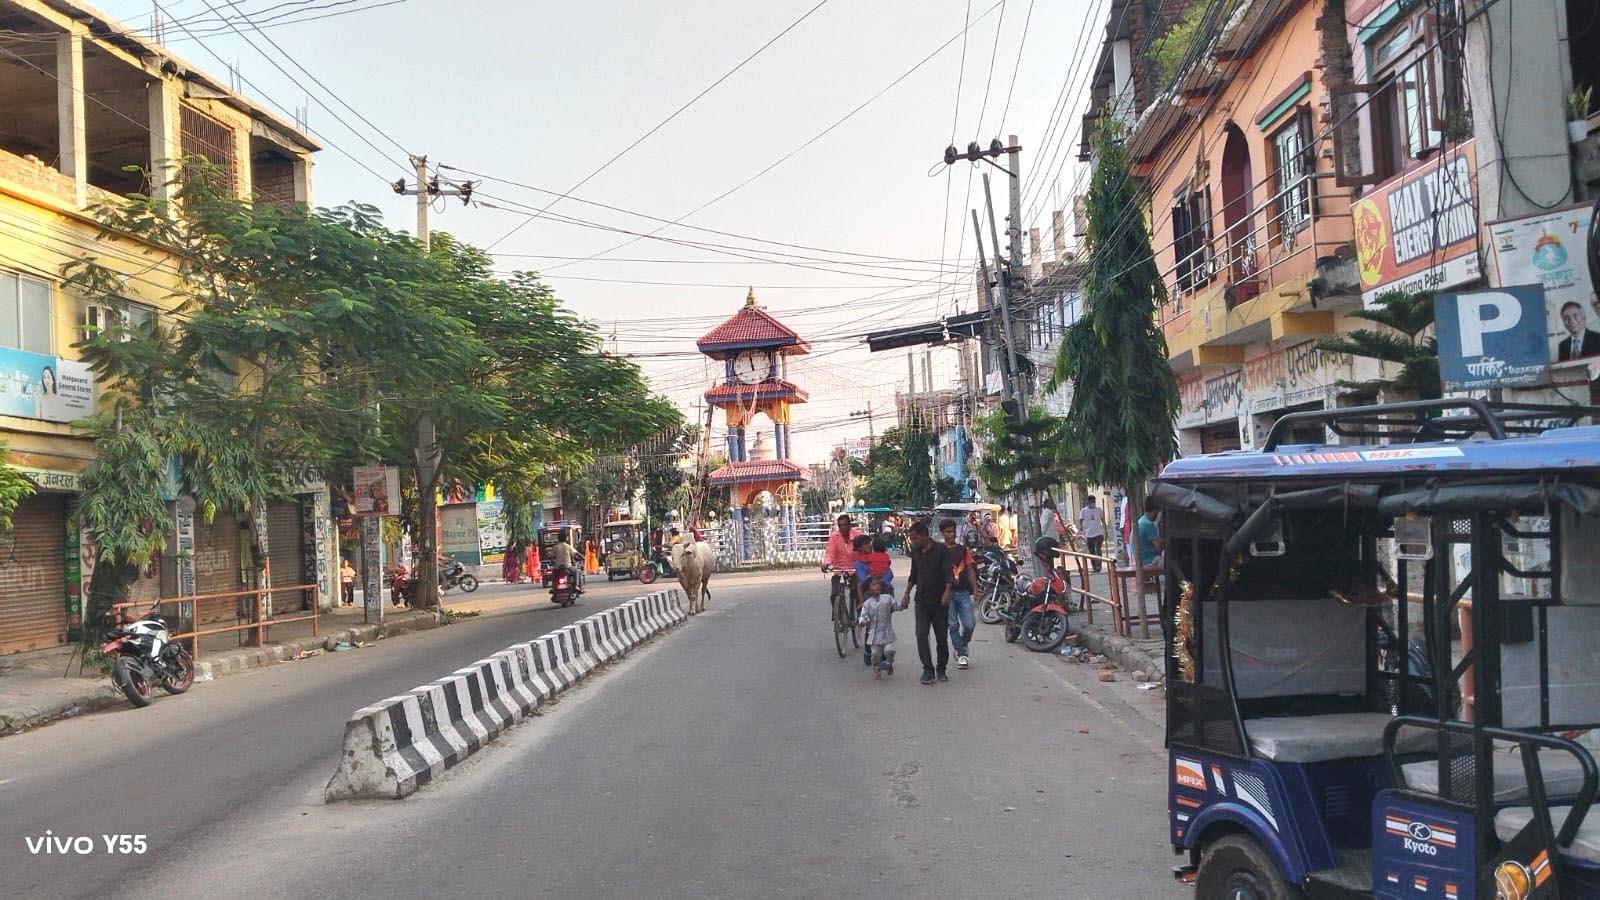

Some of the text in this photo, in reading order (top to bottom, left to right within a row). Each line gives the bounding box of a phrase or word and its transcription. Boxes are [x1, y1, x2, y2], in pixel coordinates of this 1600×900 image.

[1388, 180, 1425, 232] MAX
[1393, 201, 1477, 265] ENERGY DRINK
[1398, 278, 1423, 294] Kirana
[1424, 266, 1448, 287] Pasal
[1456, 291, 1522, 358] P
[1403, 837, 1438, 857] Kyoto
